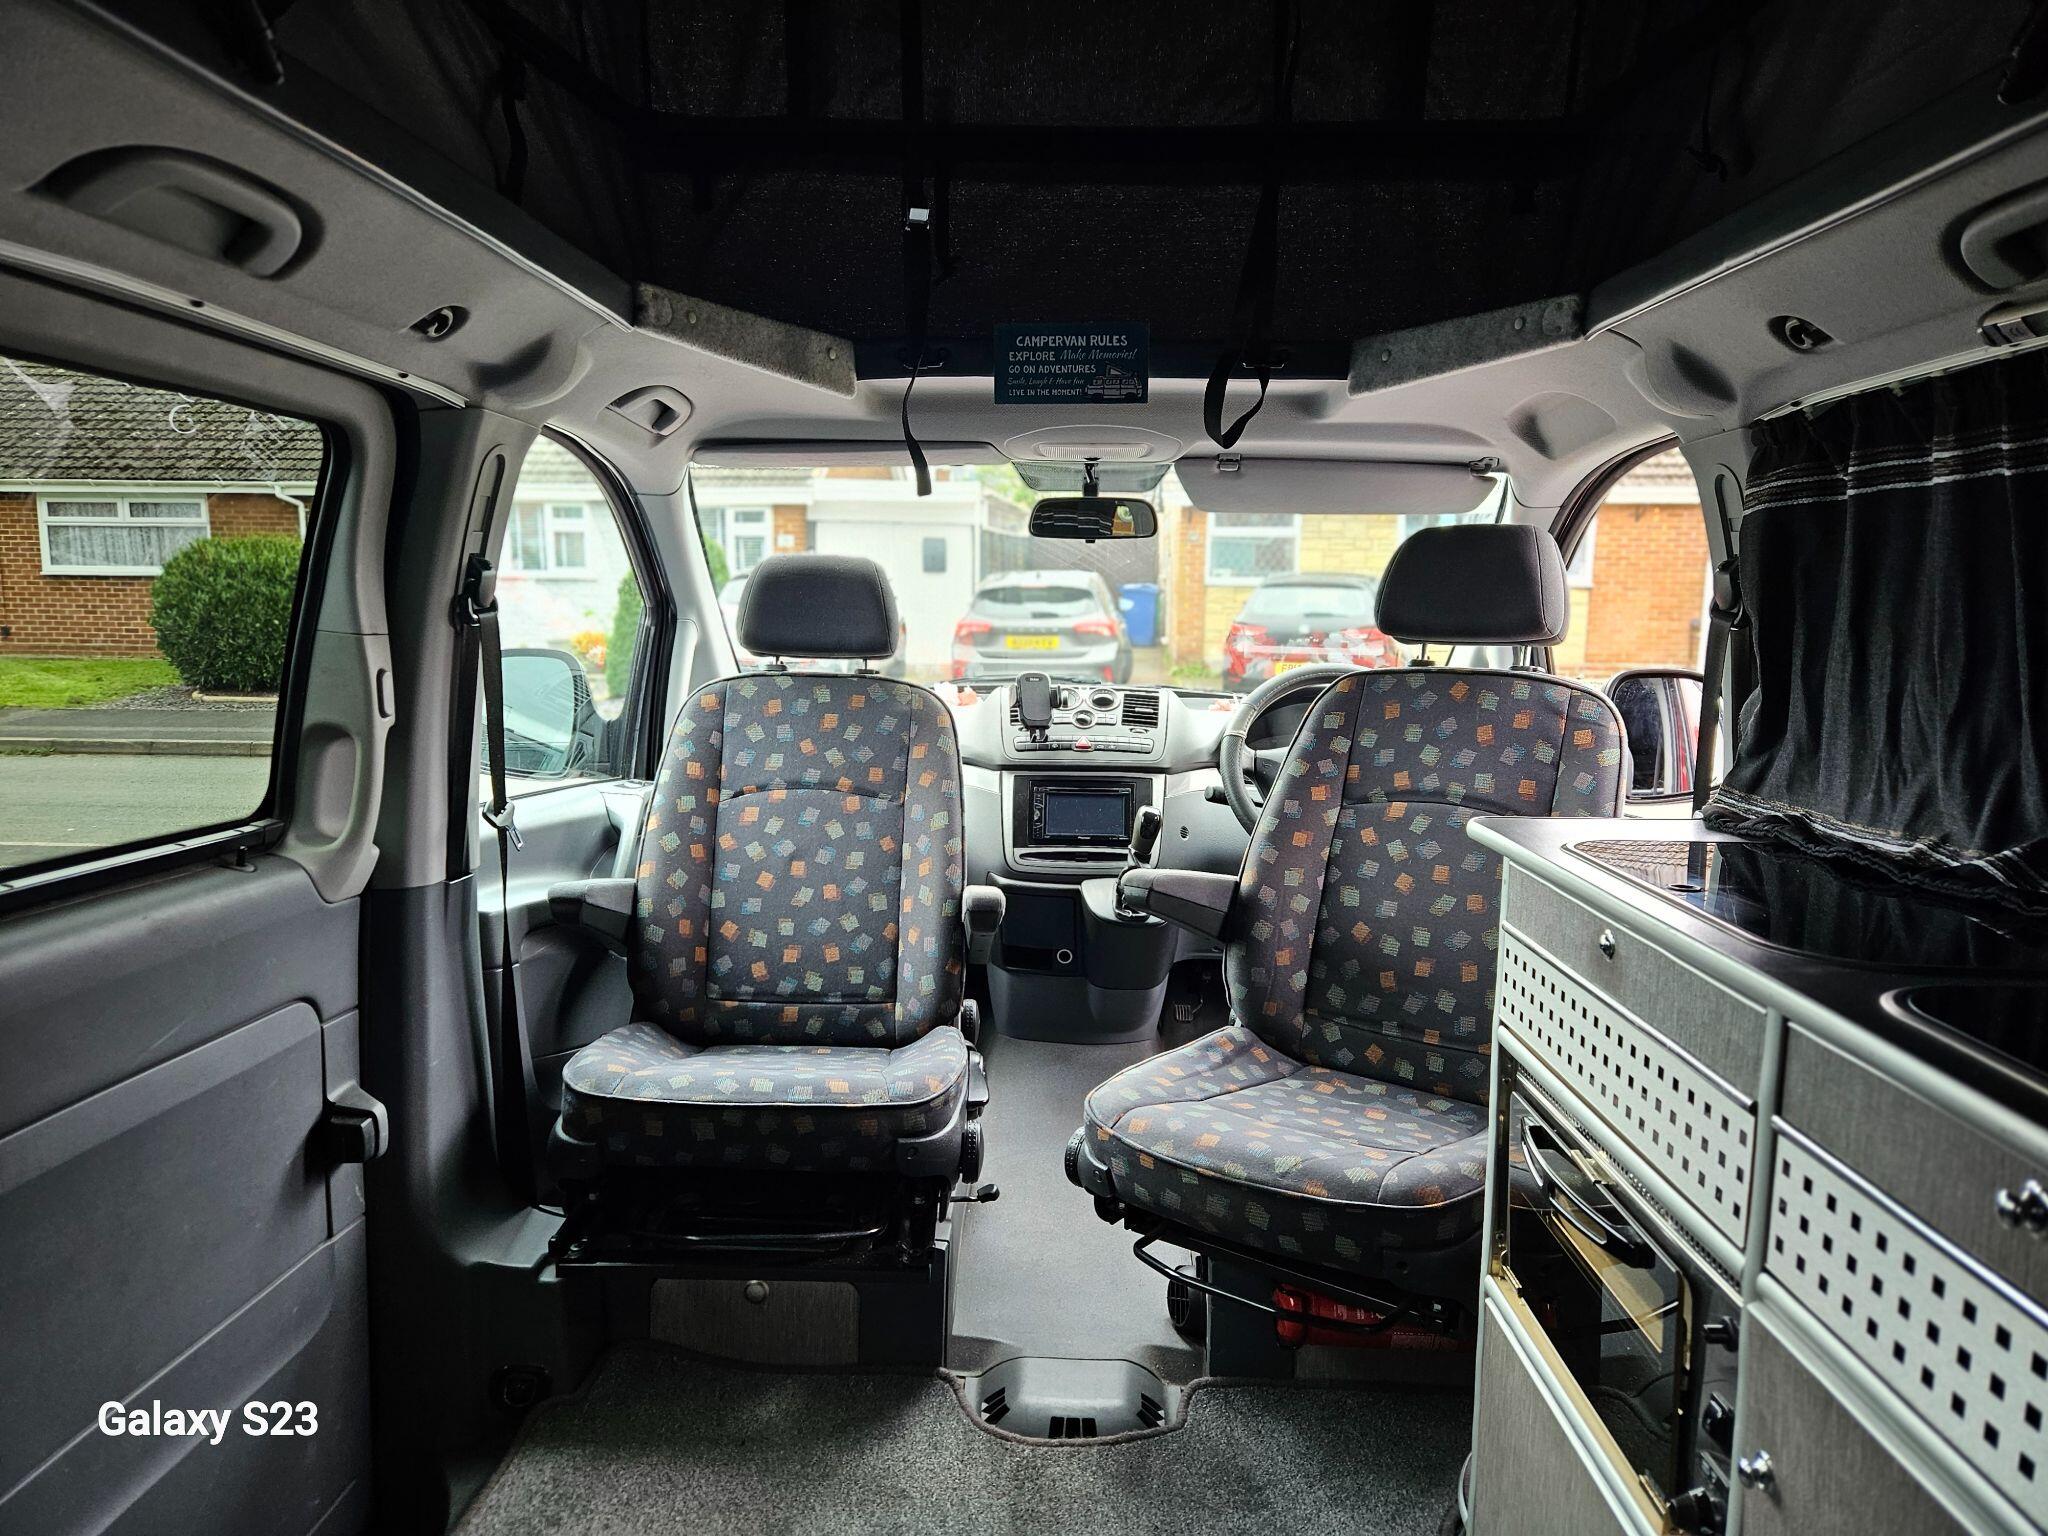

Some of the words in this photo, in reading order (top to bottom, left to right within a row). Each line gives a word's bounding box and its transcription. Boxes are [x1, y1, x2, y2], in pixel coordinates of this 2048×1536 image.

[1016, 335, 1086, 347] CAMPERVAN
[1090, 334, 1128, 346] RULES
[1008, 351, 1056, 361] EXPLORE
[1059, 348, 1086, 361] Make
[1088, 348, 1138, 360] Memories!
[1008, 364, 1021, 374] GO
[1023, 364, 1036, 374] ON
[1038, 364, 1096, 374] ADVENTURES
[1008, 388, 1025, 396] LIVE
[1027, 388, 1035, 396] IN
[1037, 388, 1050, 396] THE
[1051, 388, 1082, 396] MOMENT!
